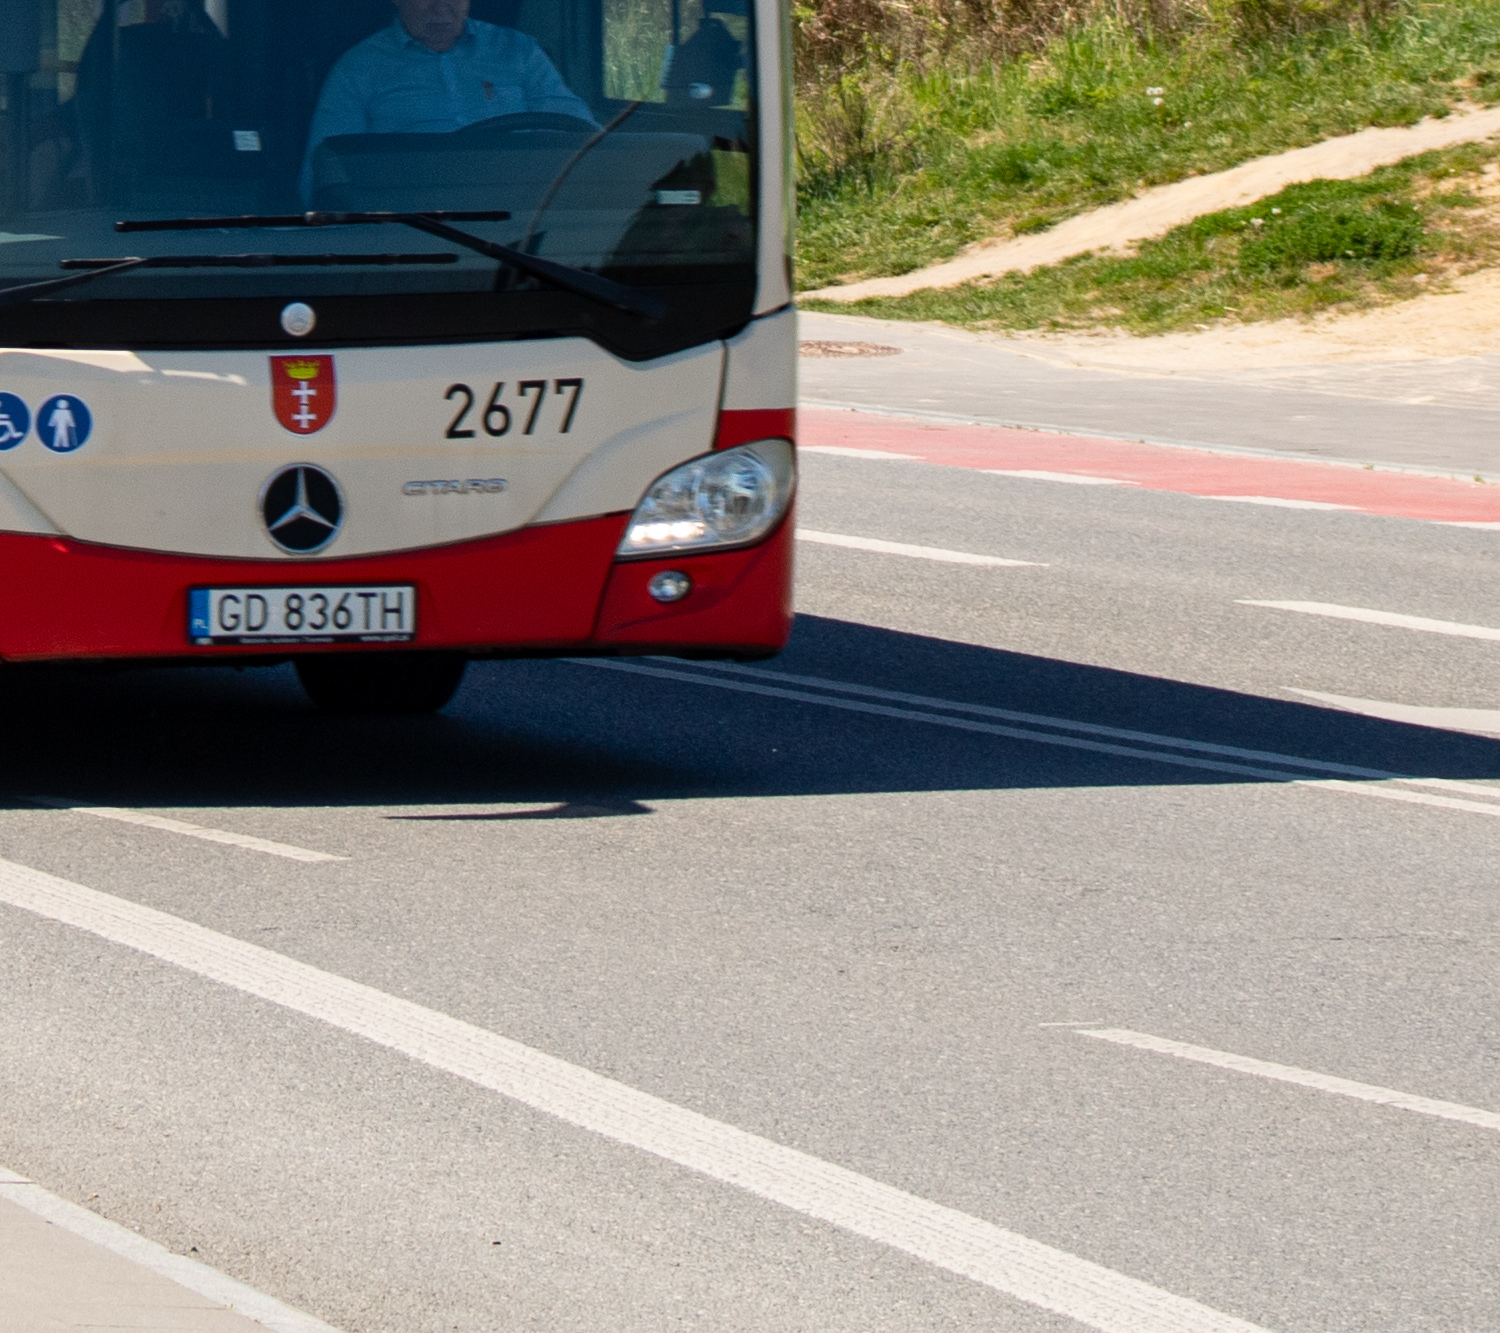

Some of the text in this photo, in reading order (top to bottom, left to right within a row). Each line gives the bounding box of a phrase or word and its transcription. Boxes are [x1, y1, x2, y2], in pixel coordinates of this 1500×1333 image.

[443, 377, 585, 439] 2677
[217, 591, 406, 632] GD 836TH
